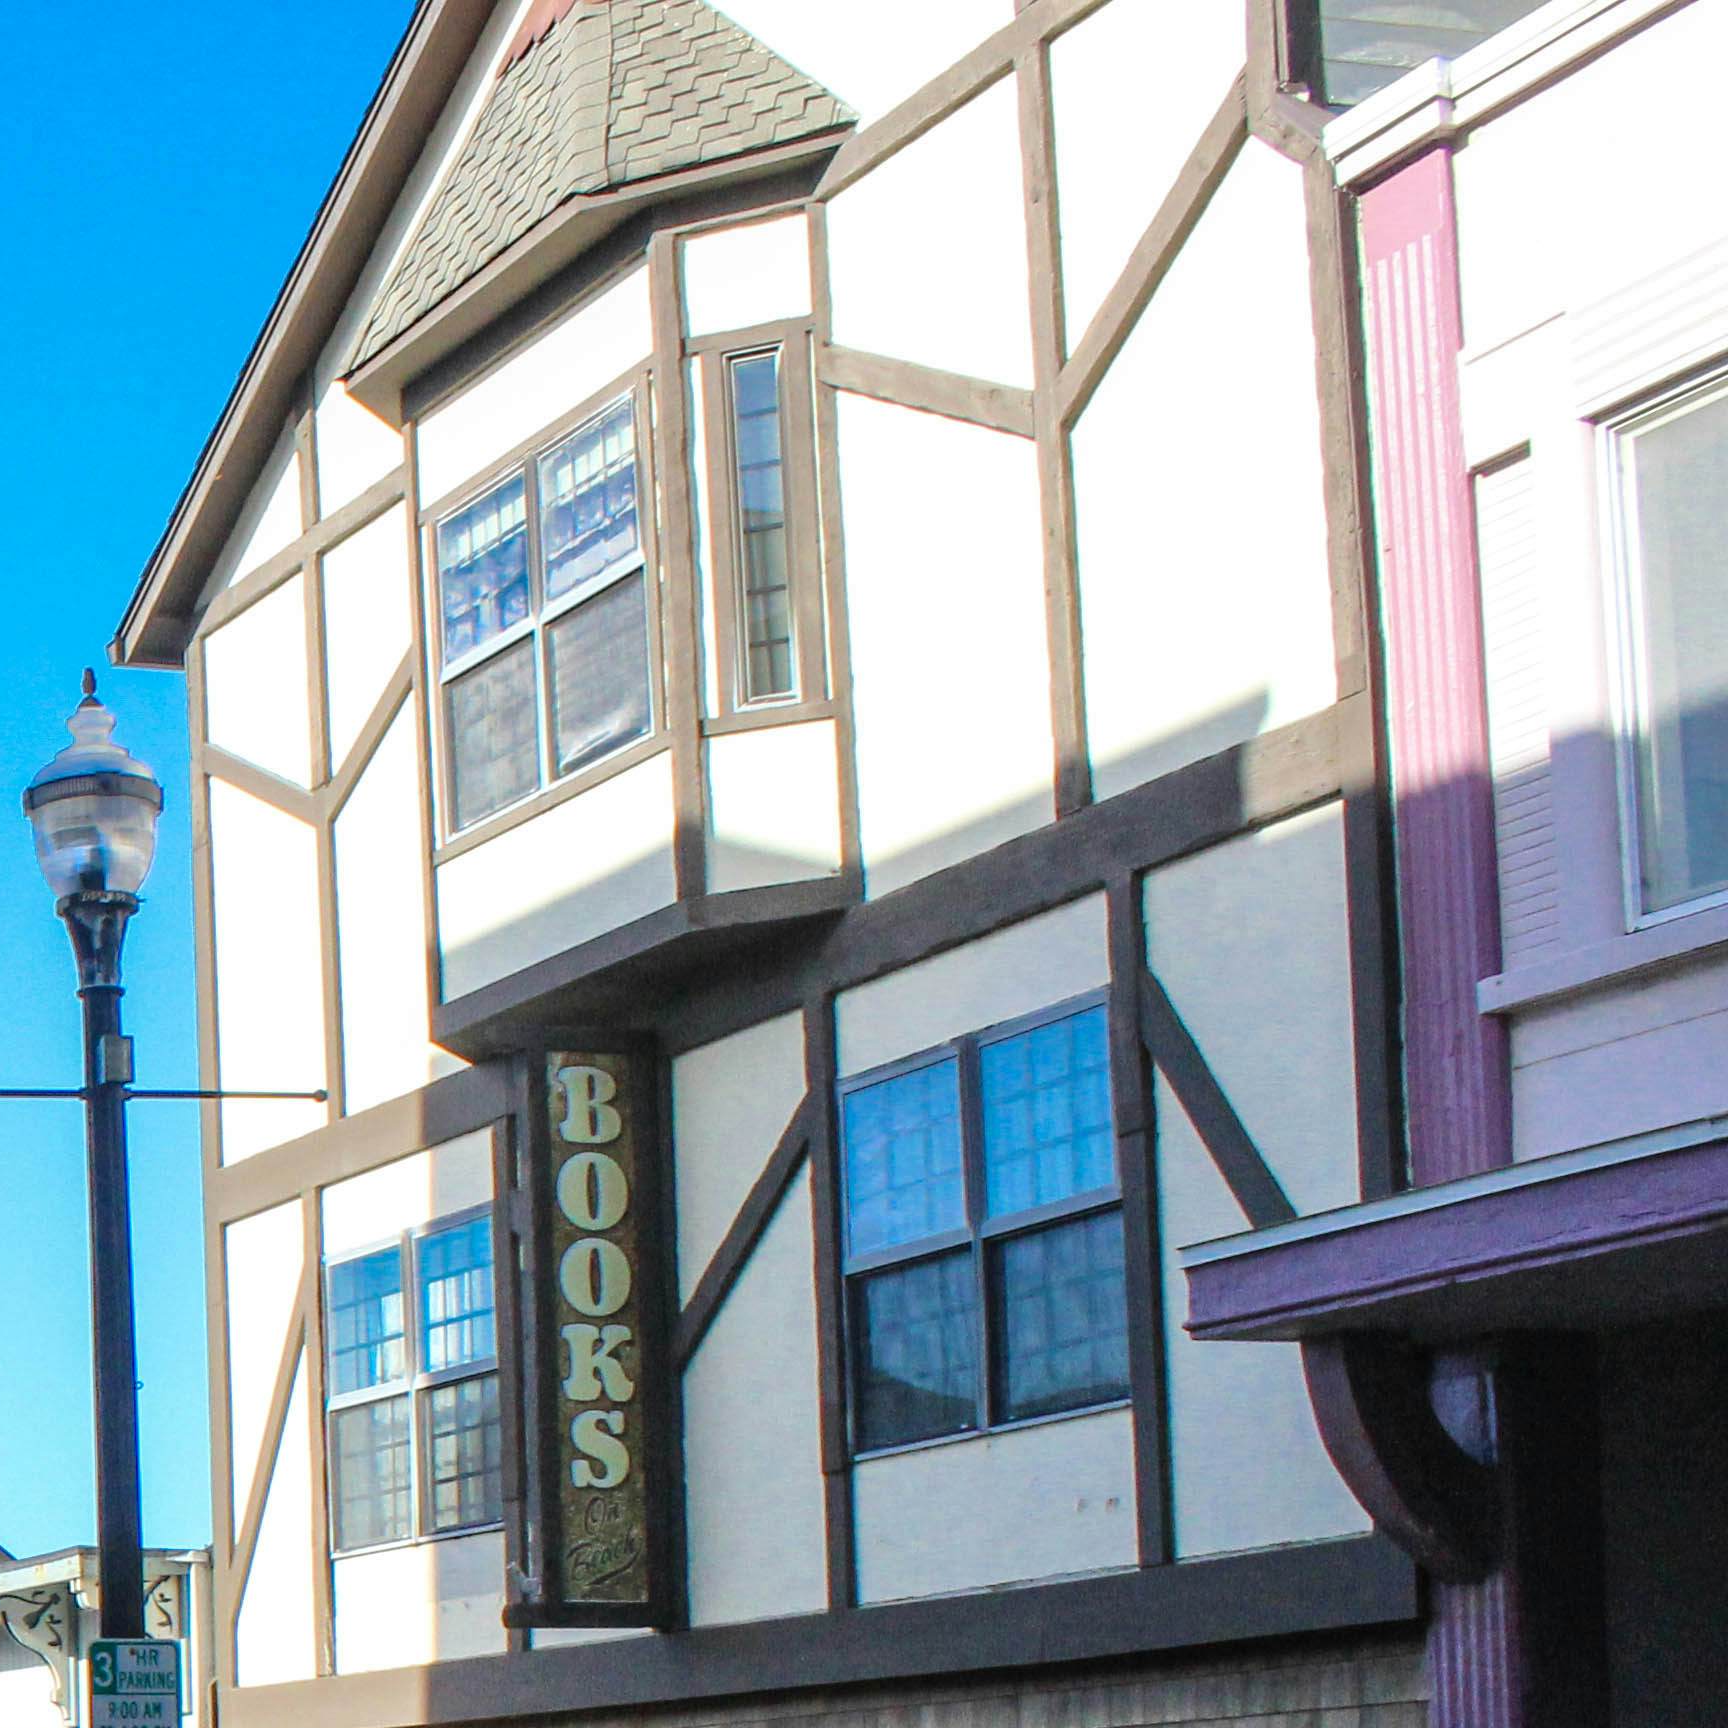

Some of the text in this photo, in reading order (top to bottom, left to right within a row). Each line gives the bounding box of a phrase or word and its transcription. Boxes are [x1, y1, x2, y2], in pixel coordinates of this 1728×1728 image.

[556, 1065, 635, 1490] BOOKS
[95, 1649, 159, 1687] 3 HR
[118, 1672, 176, 1689] PARKING
[108, 1701, 163, 1719] 9:00 AM
